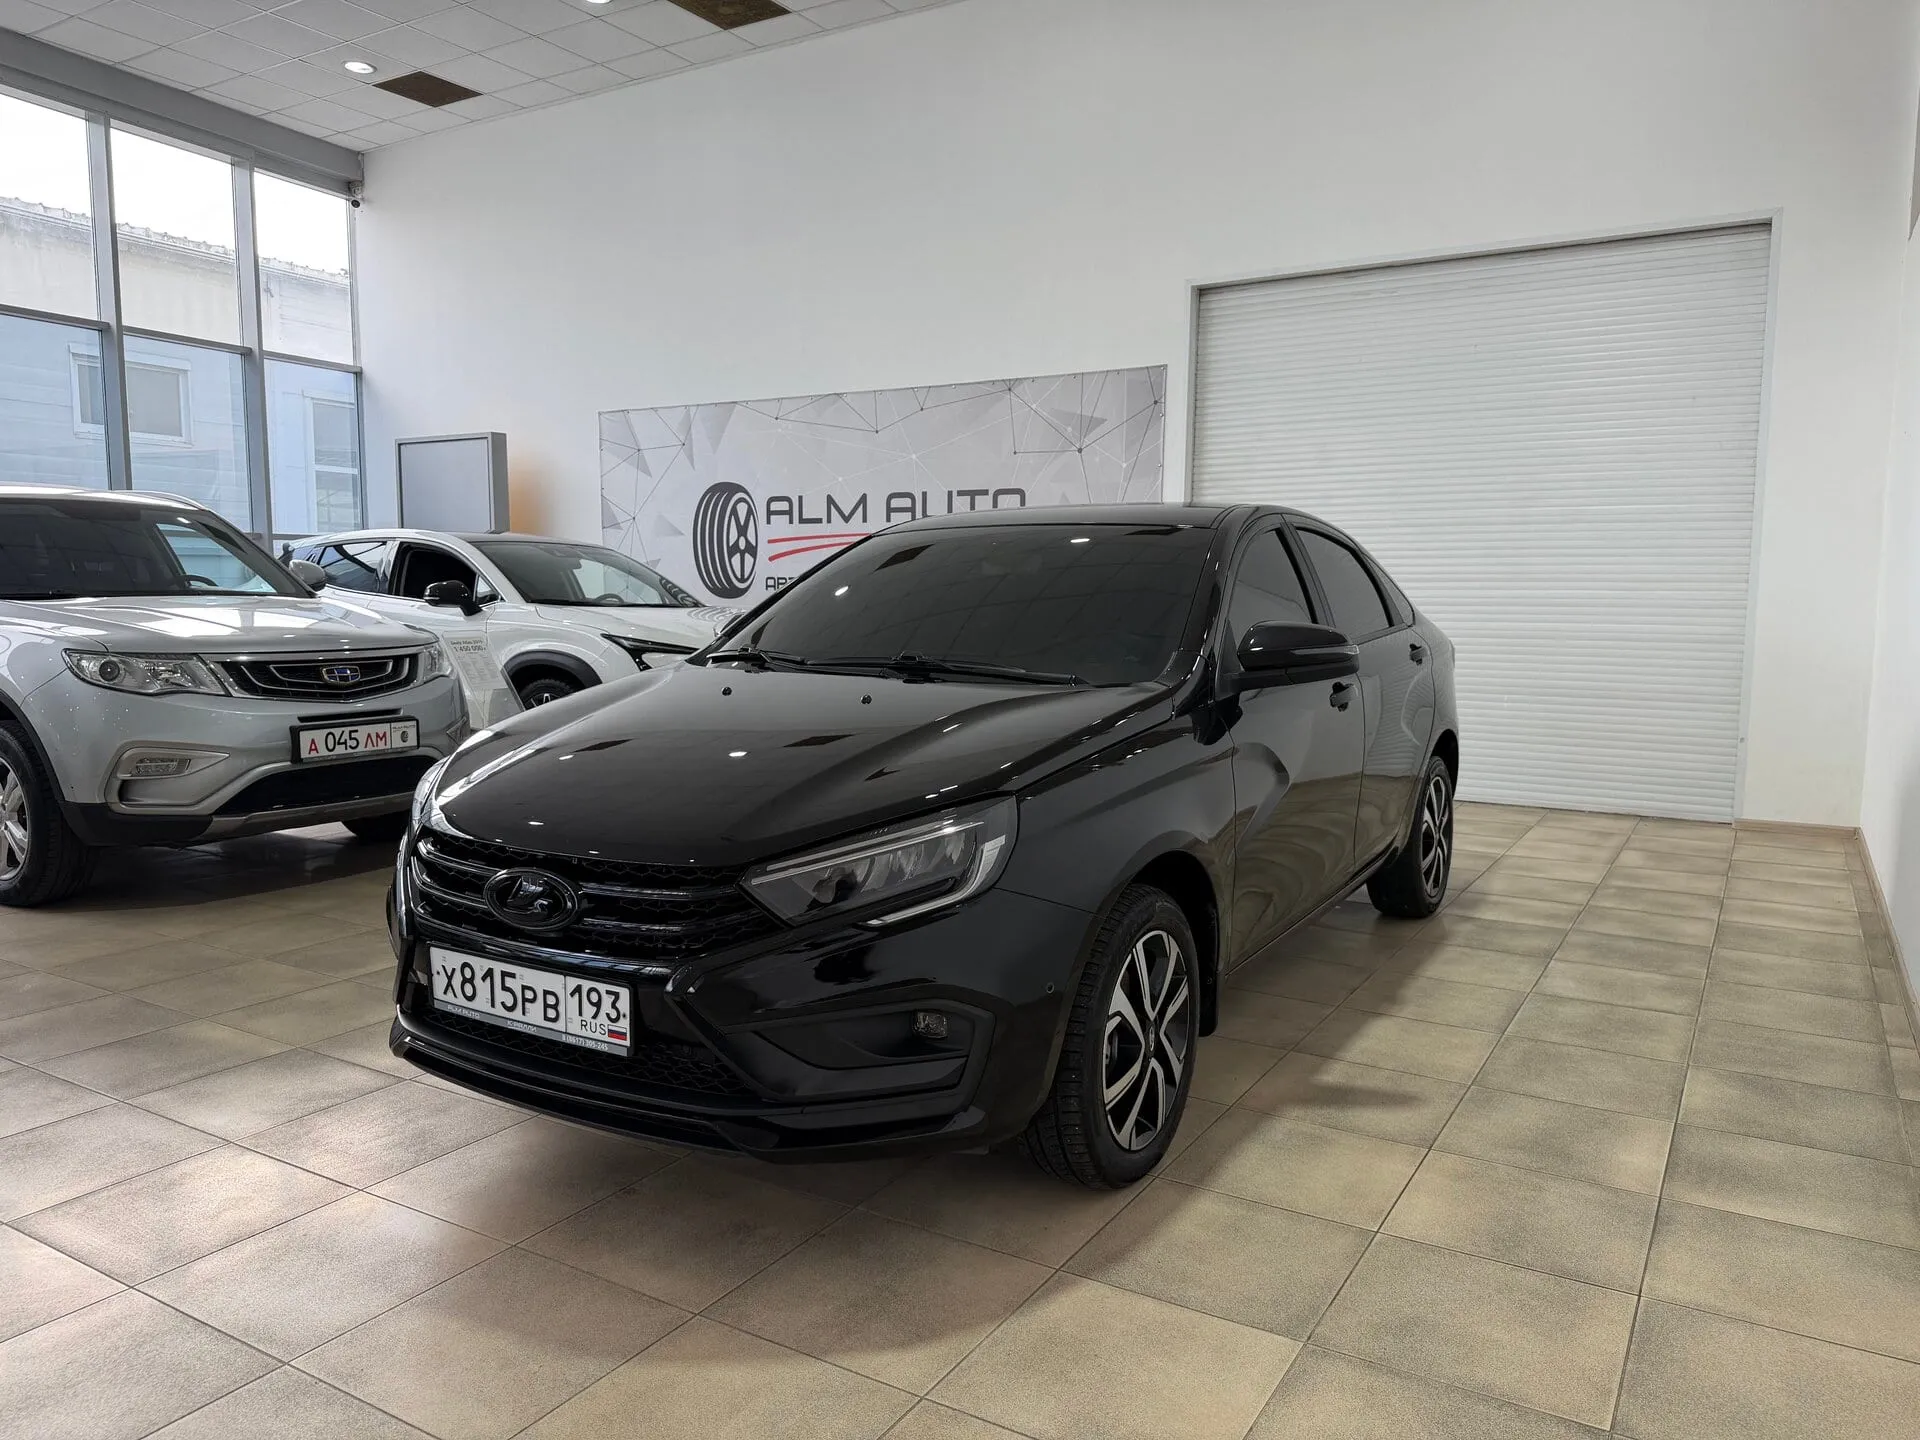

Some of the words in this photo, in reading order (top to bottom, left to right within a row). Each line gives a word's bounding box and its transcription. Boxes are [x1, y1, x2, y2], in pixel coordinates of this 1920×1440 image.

[766, 493, 868, 525] ALM
[885, 487, 1026, 523] AUTO
[325, 729, 360, 752] 045
[569, 984, 622, 1023] 193
[580, 1019, 607, 1036] RUS
